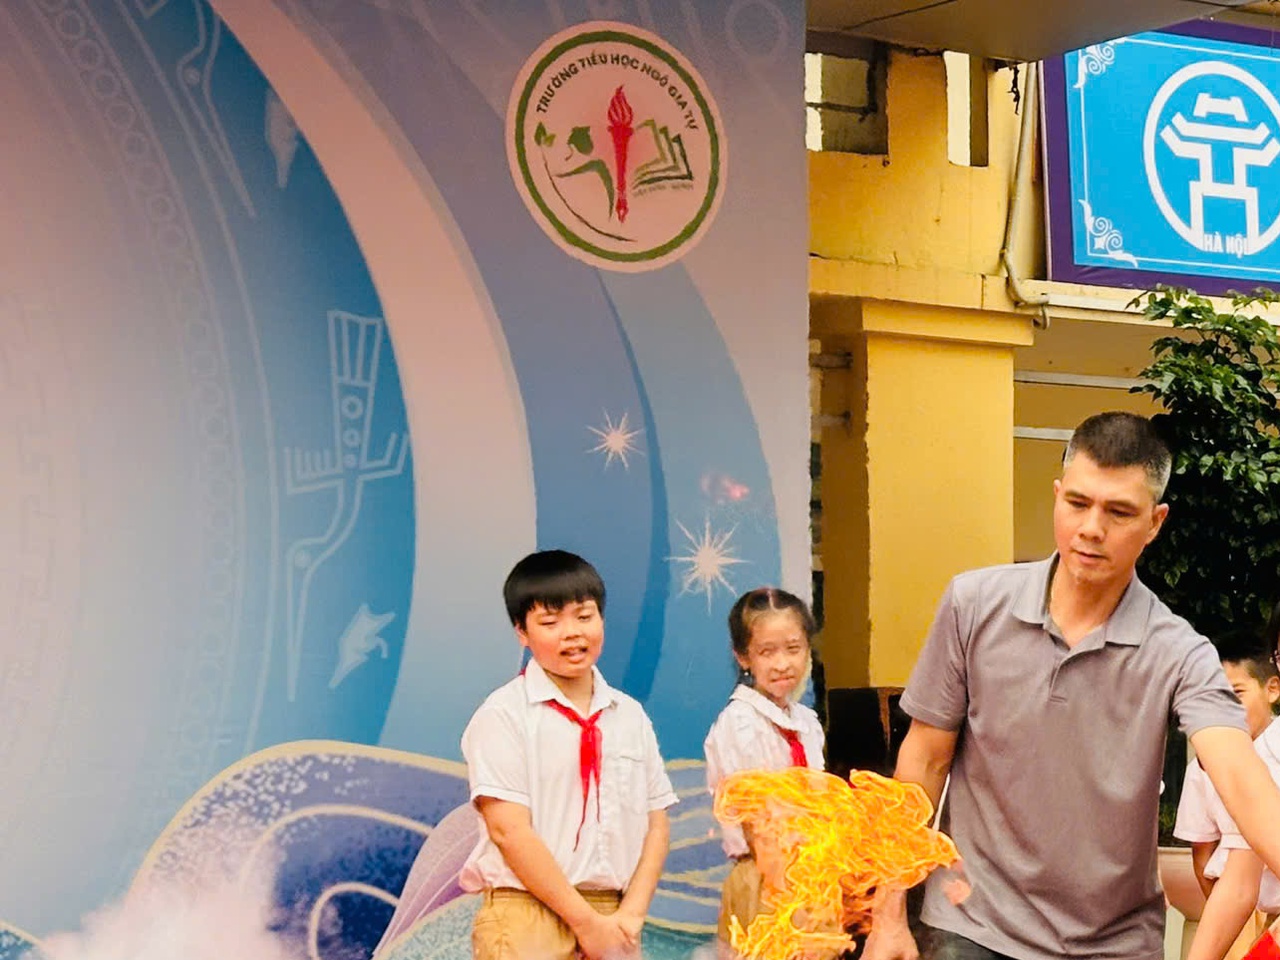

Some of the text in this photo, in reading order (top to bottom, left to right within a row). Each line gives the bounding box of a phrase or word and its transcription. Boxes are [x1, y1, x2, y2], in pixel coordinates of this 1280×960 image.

[536, 63, 579, 114] TRƯỜNG
[610, 53, 640, 70] HỌC
[640, 62, 669, 88] NGÔ
[668, 84, 689, 111] GIA
[1204, 231, 1249, 259] HÀ NỘI
